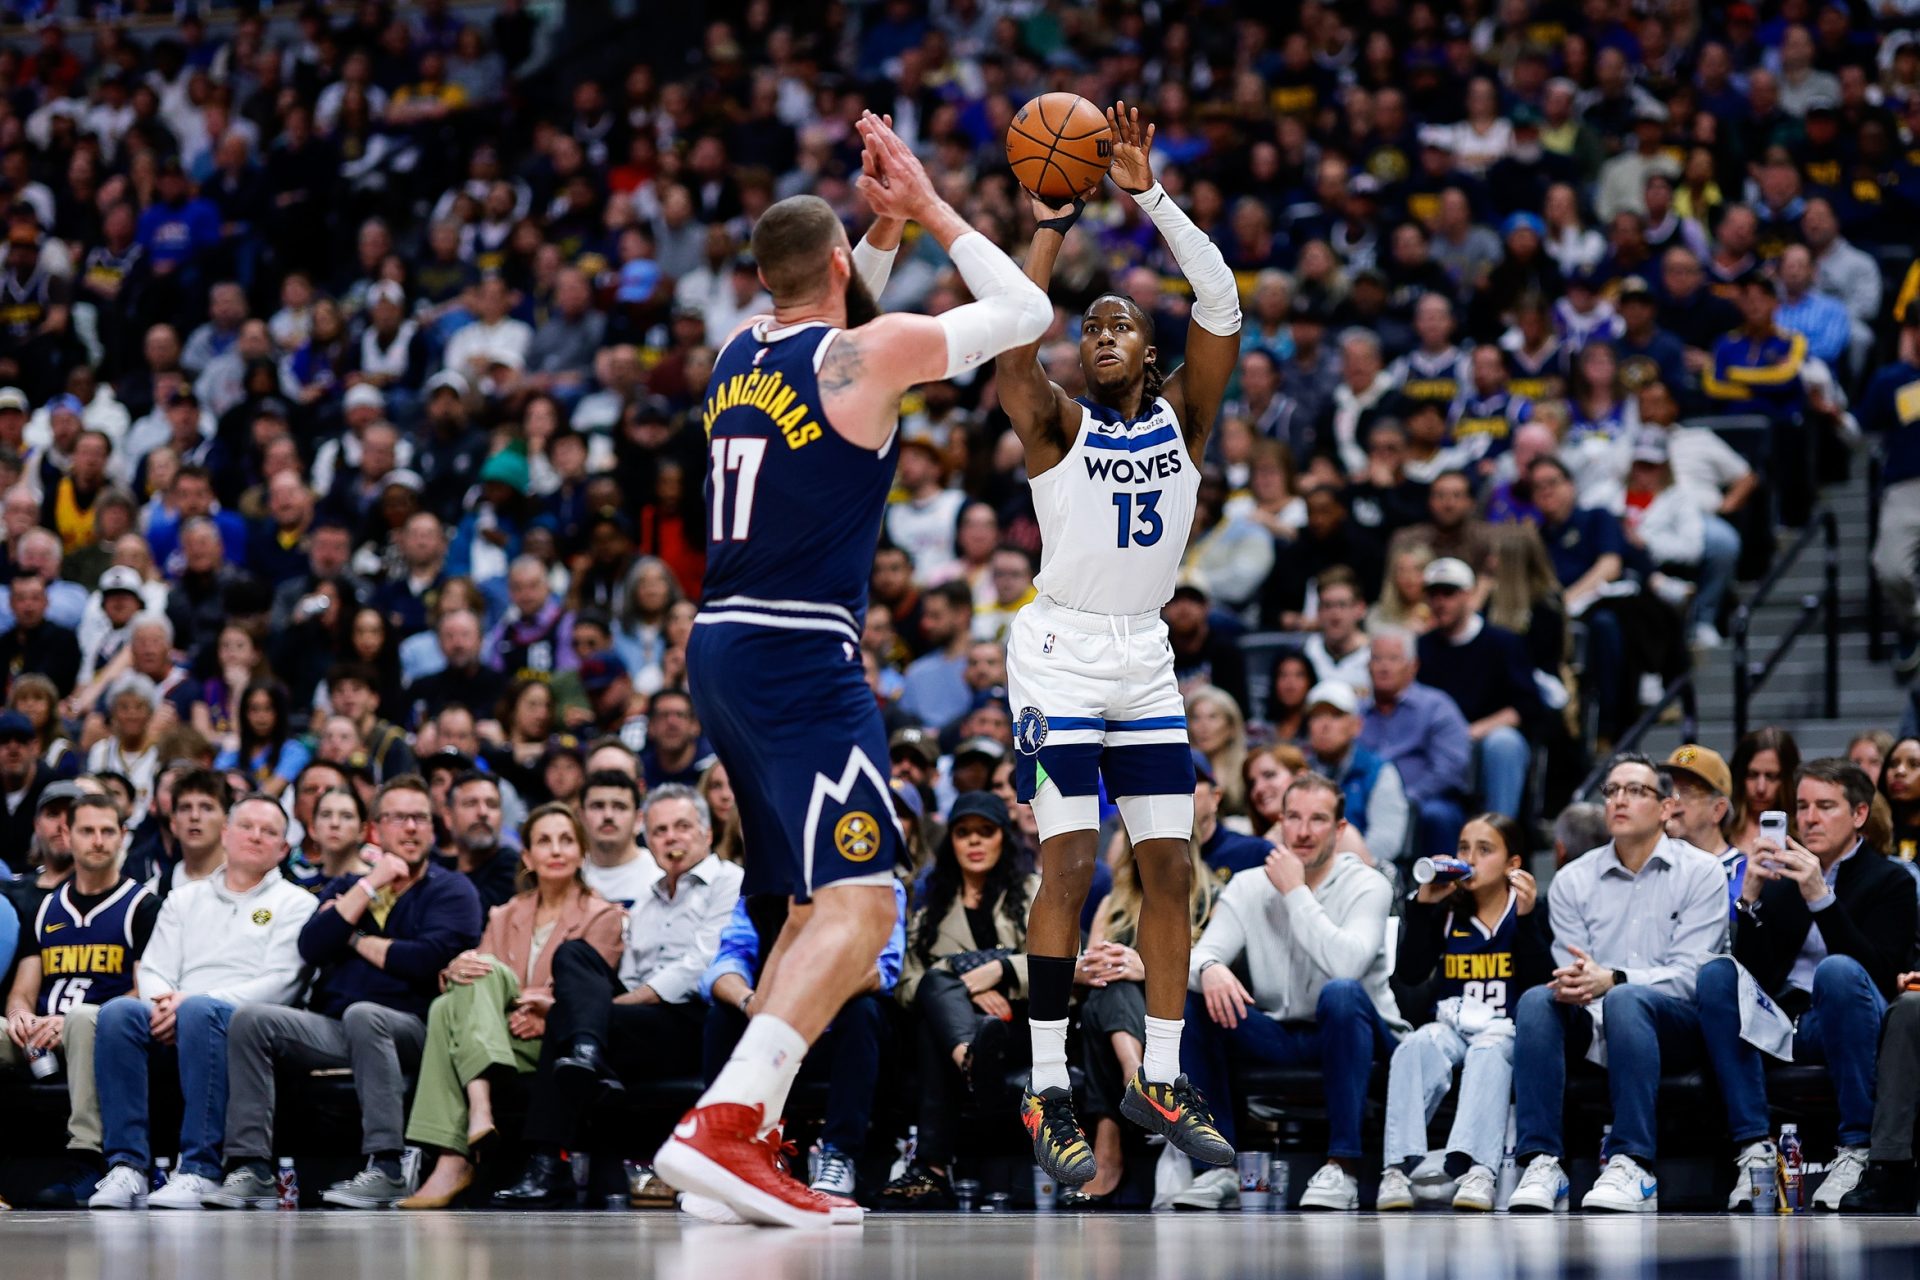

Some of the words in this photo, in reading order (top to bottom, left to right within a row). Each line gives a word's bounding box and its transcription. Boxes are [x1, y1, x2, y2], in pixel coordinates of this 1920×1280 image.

[1084, 450, 1182, 484] WOLVES
[711, 437, 768, 542] 17
[1112, 489, 1164, 549] 13
[1445, 952, 1513, 979] DENVE
[47, 977, 94, 1015] 15
